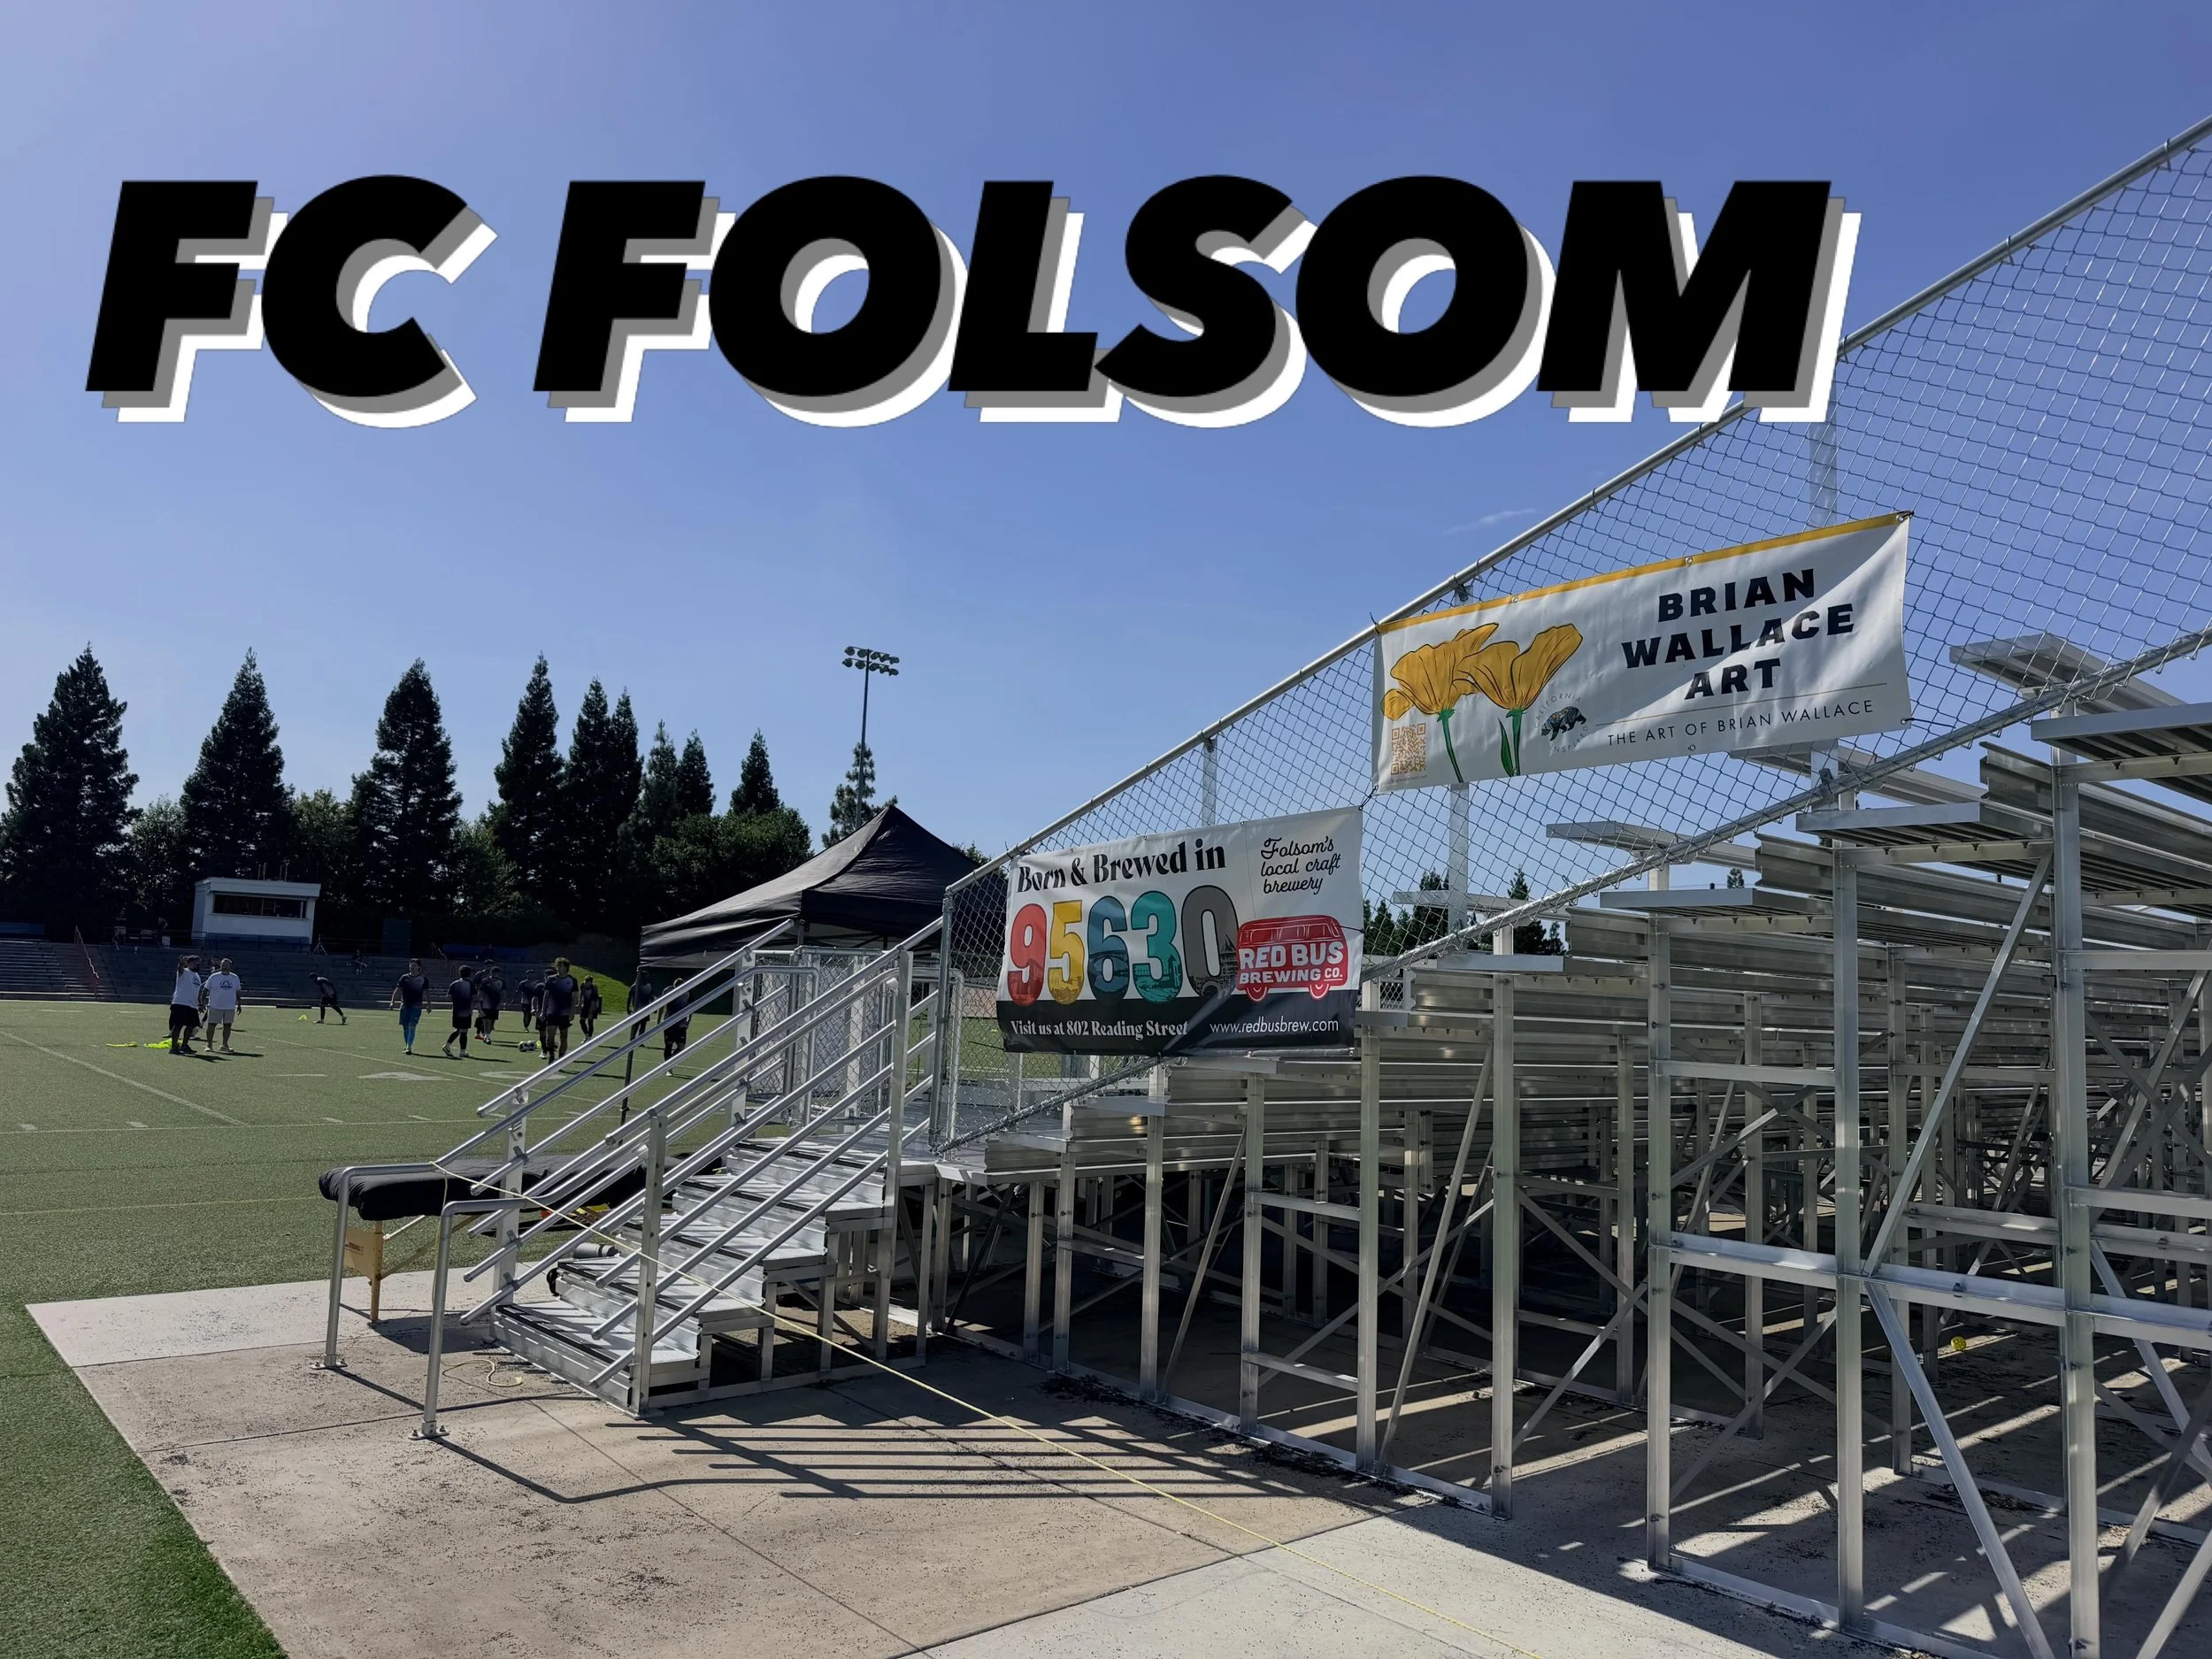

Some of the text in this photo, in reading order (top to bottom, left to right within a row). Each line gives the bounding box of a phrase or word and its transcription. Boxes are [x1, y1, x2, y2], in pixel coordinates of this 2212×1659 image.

[1658, 568, 1815, 622] BRIAN
[1621, 603, 1855, 669] WALLACE
[1684, 657, 1781, 700] ART
[1608, 700, 1874, 746] THE ART OF BRIAN WALLACE
[1550, 726, 1588, 753] NSPIRED
[1261, 835, 1334, 859] Folsom's
[1017, 838, 1227, 893] Born & Brewed in
[1261, 853, 1340, 877] local craft
[1263, 876, 1324, 895] brewery
[1007, 885, 1240, 1007] 95630
[1239, 941, 1344, 970] RED BUS
[1239, 967, 1343, 985] BREWING CO.
[1010, 1019, 1188, 1041] Visit us at 802 Reading Street
[1210, 1015, 1340, 1033] www.redbusbrew.com
